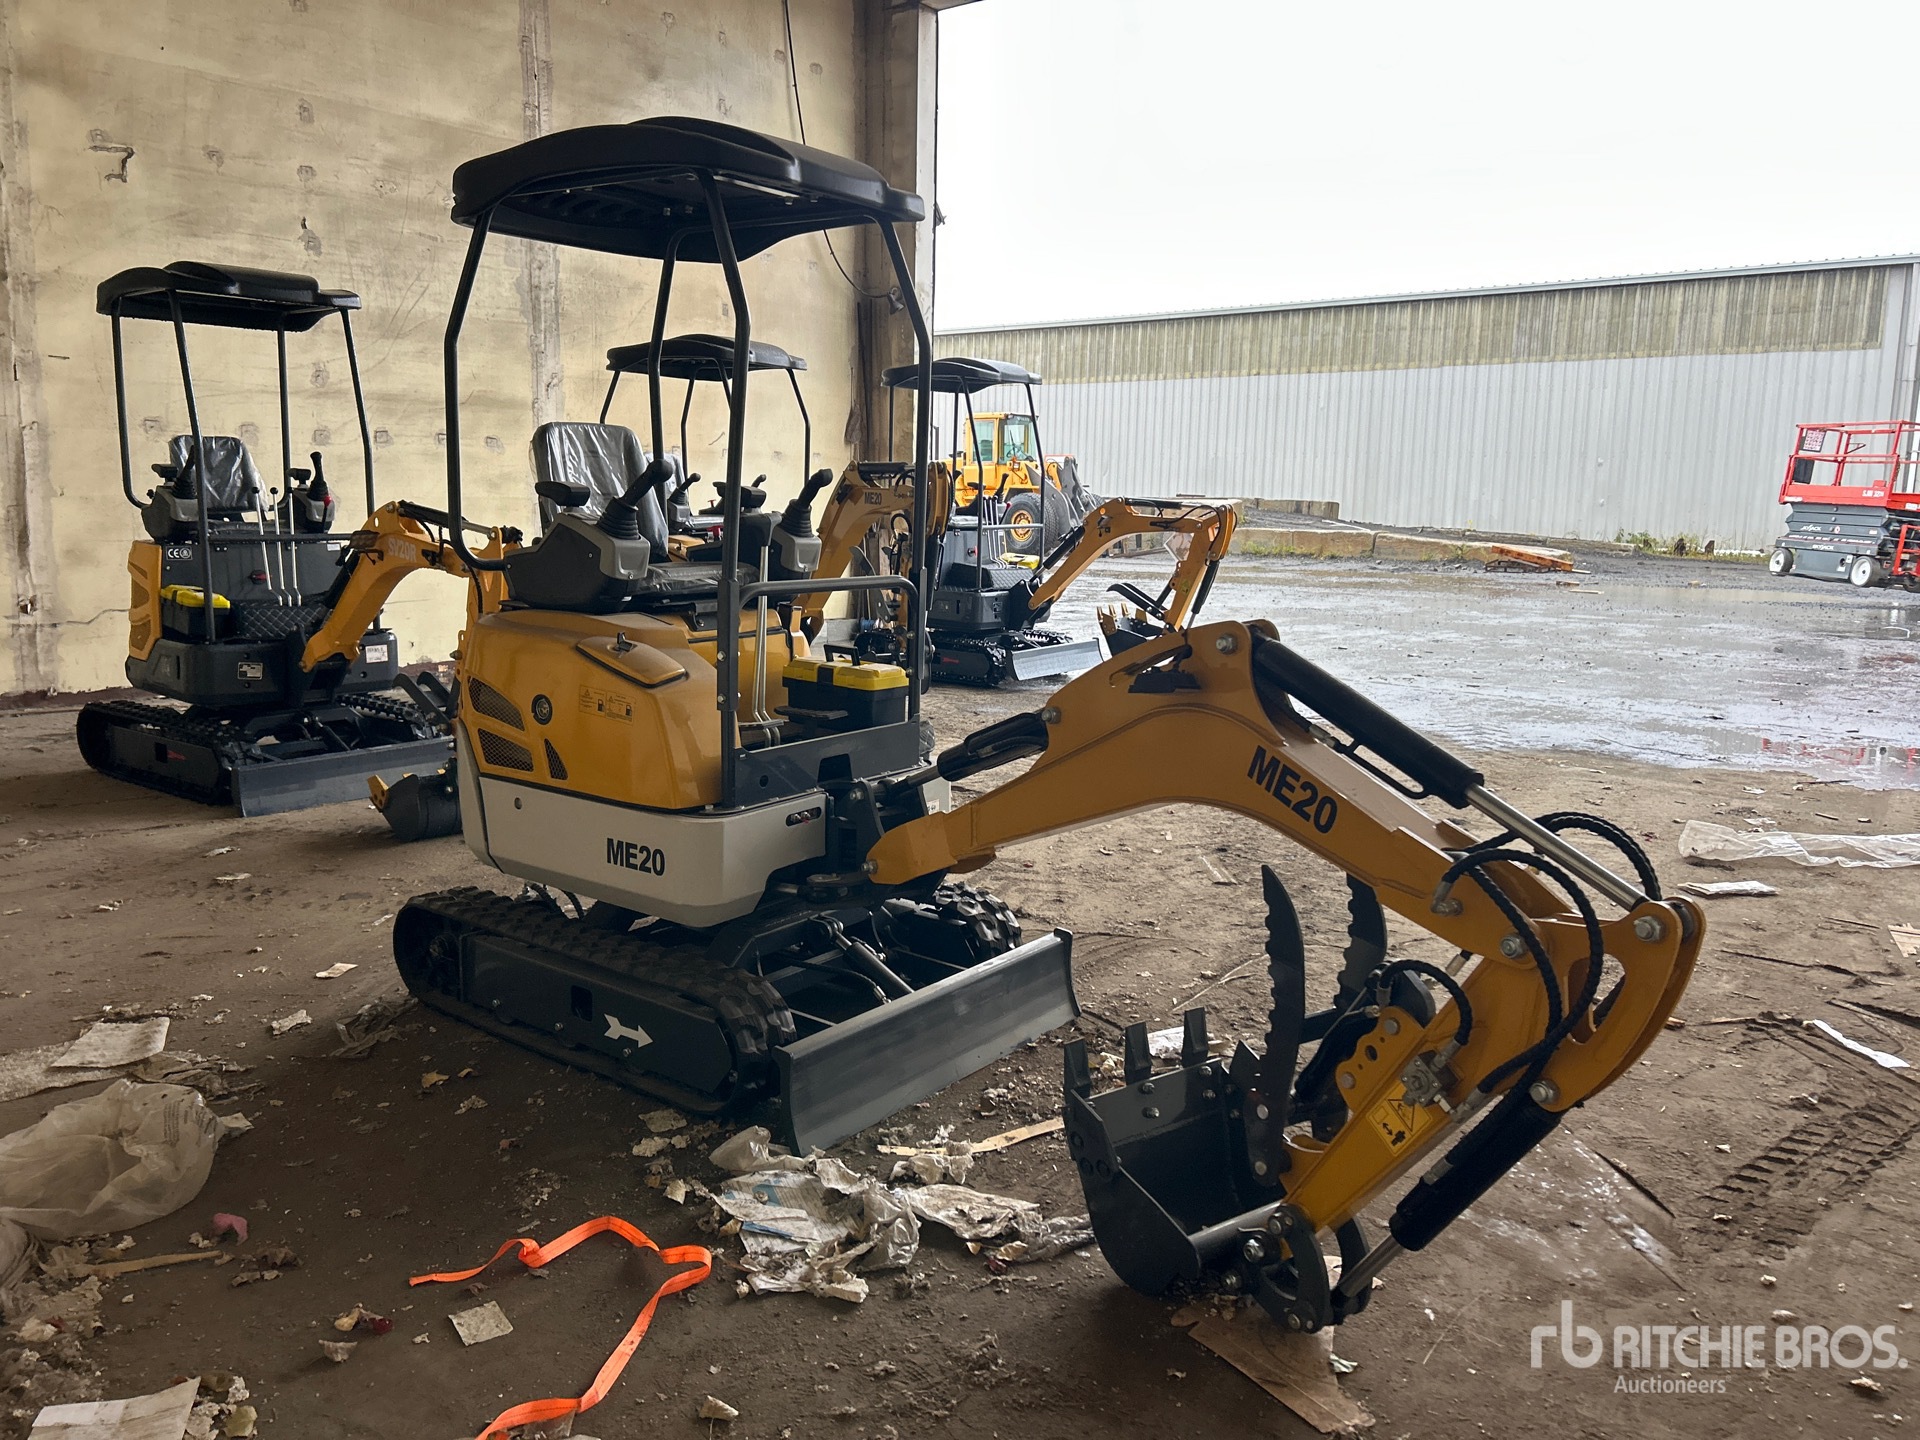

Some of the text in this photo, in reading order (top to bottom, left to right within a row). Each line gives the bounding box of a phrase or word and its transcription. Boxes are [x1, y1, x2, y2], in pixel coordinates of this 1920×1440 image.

[864, 491, 882, 505] ME20
[387, 537, 417, 563] SV20R
[1247, 744, 1338, 834] ME20
[606, 837, 665, 876] ME20
